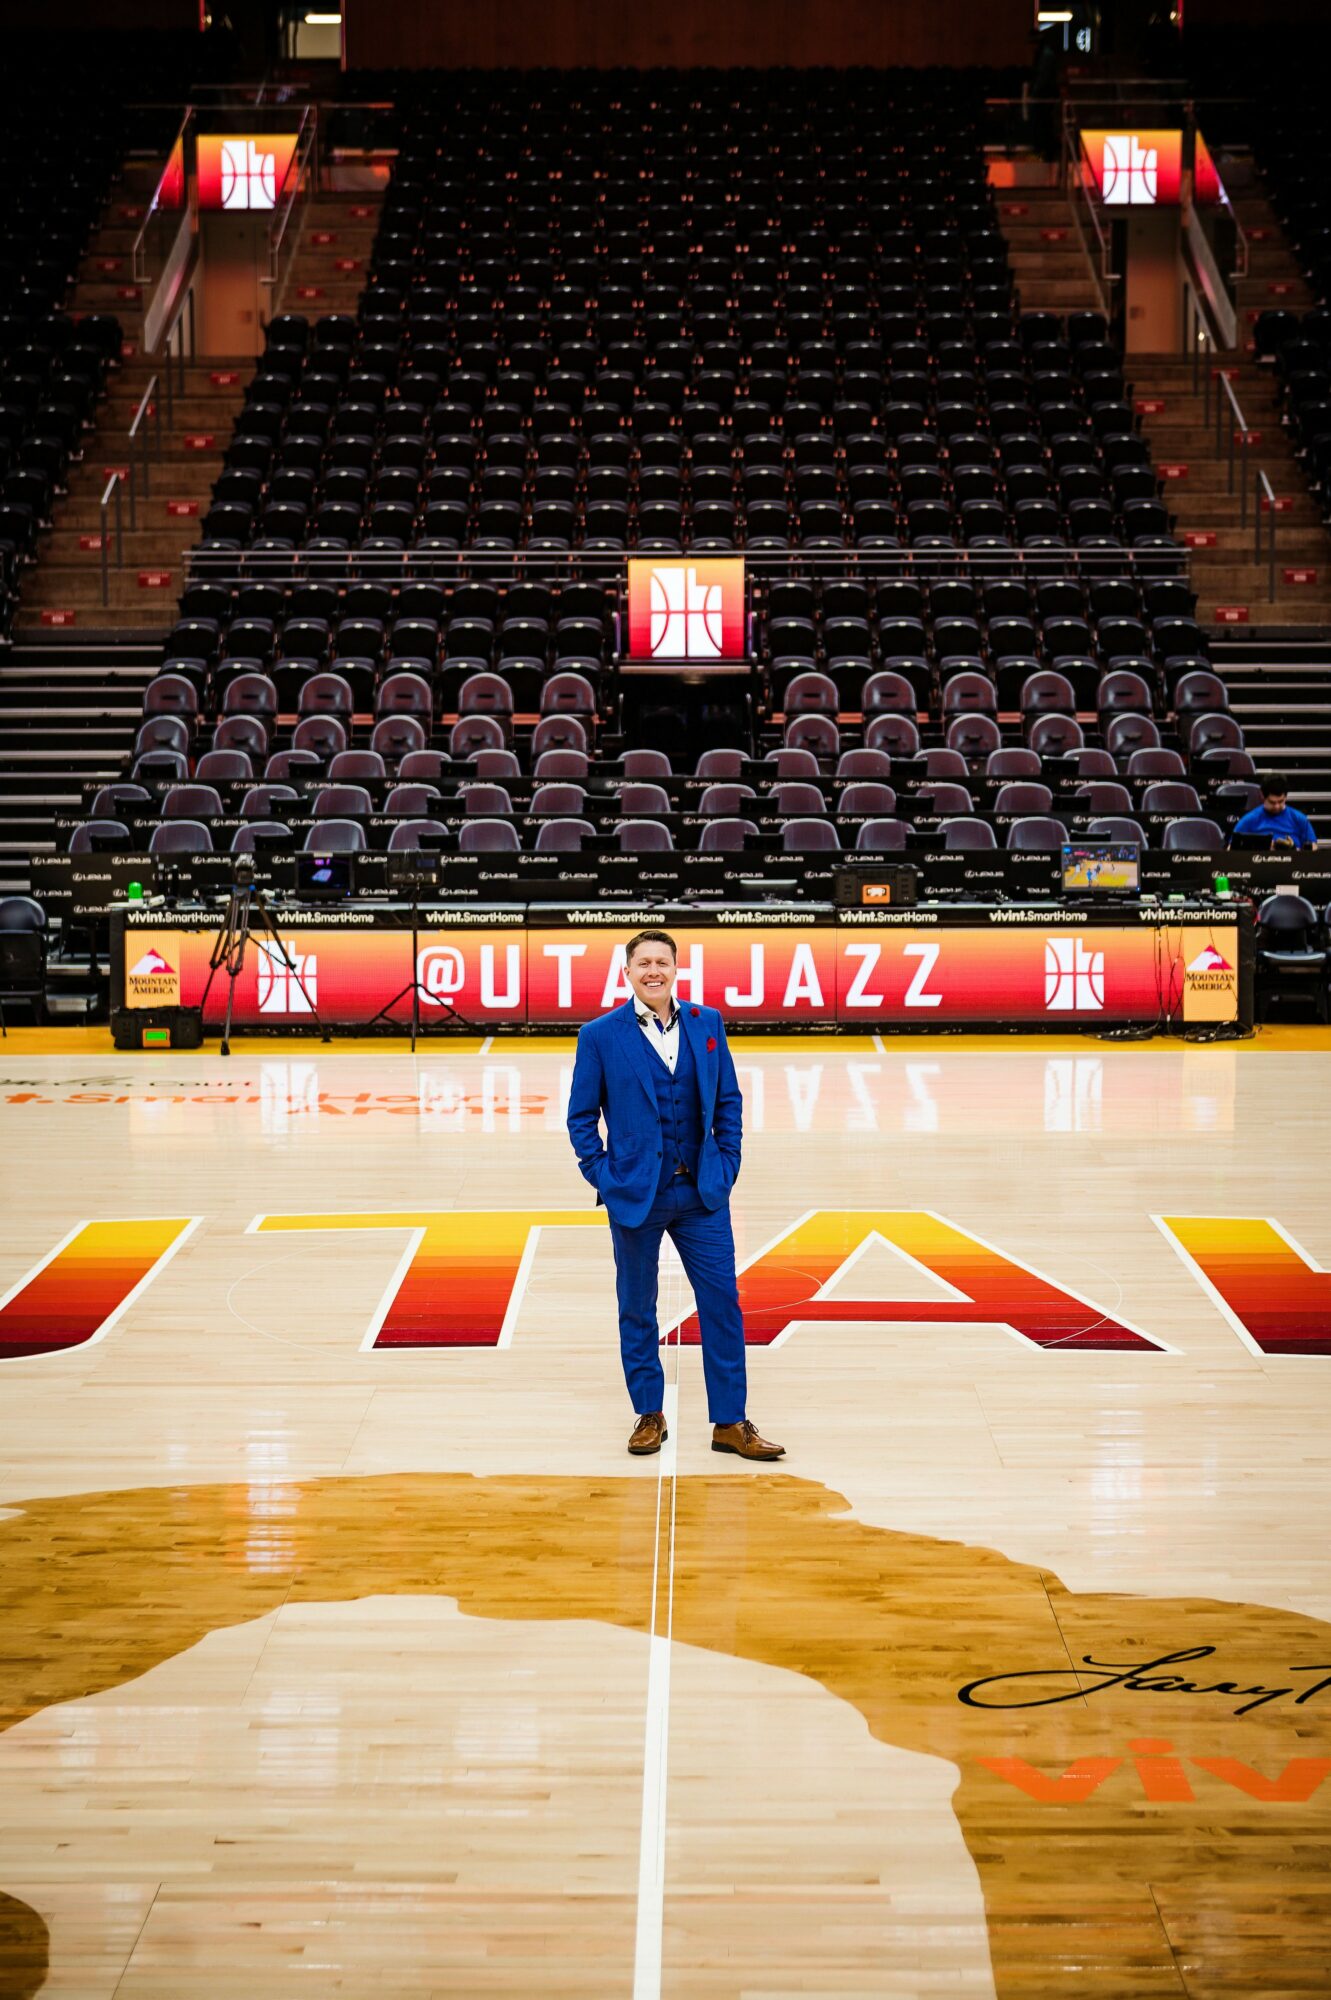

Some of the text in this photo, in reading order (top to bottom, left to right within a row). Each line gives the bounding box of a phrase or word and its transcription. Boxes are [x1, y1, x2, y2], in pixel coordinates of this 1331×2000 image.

[128, 910, 224, 923] vivint.SmartHome
[277, 910, 374, 923] vivint.SmartHome
[426, 910, 524, 923] vivint.SmartHome
[567, 910, 665, 923] vivint.SmartHome
[717, 910, 815, 923] vivint.SmartHome
[839, 910, 937, 923] vivint.SmartHome
[989, 909, 1087, 922] vivint.SmartHome
